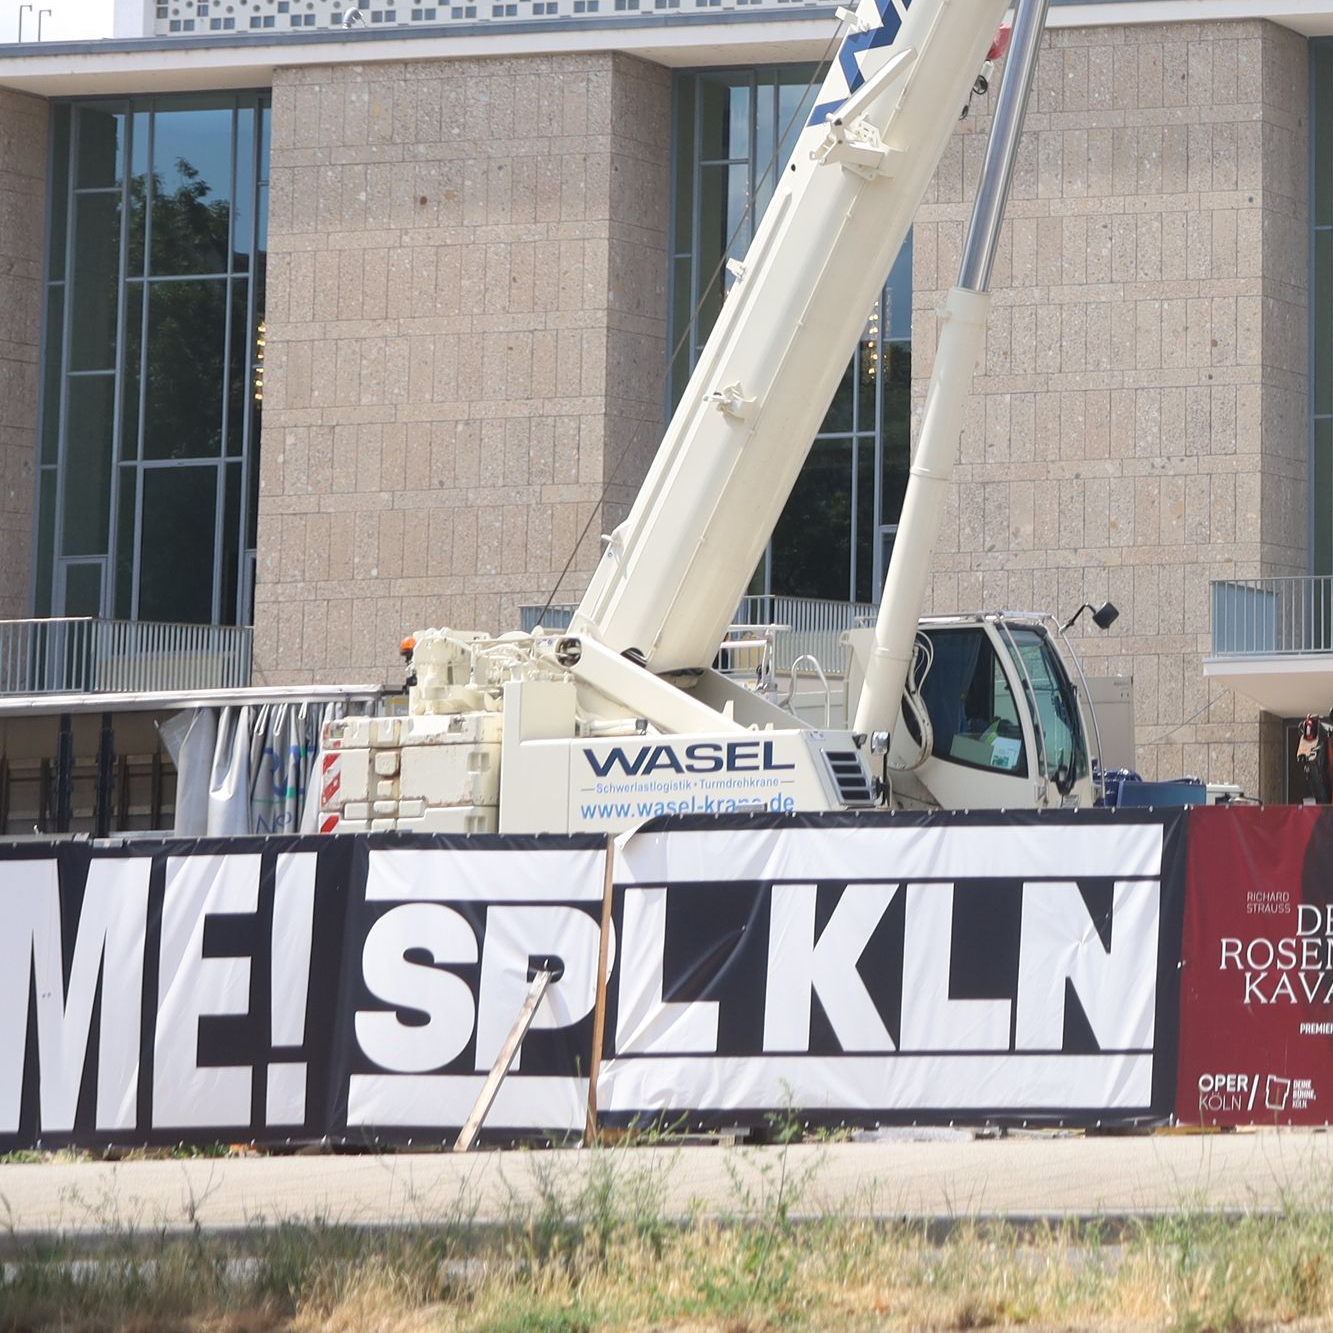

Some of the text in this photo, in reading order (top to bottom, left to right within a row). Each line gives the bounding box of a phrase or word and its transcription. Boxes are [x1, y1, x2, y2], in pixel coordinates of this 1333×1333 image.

[583, 741, 795, 777] WASEL
[596, 777, 779, 795] Schwerlastlogistik Turmdrehkrane
[1247, 892, 1290, 902] RICHARD
[1246, 903, 1291, 914] STRAUSS
[762, 881, 1160, 1052] KLN
[0, 851, 318, 1132] ME!
[1199, 1073, 1249, 1092] OPER
[1199, 1091, 1242, 1111] KÖLN
